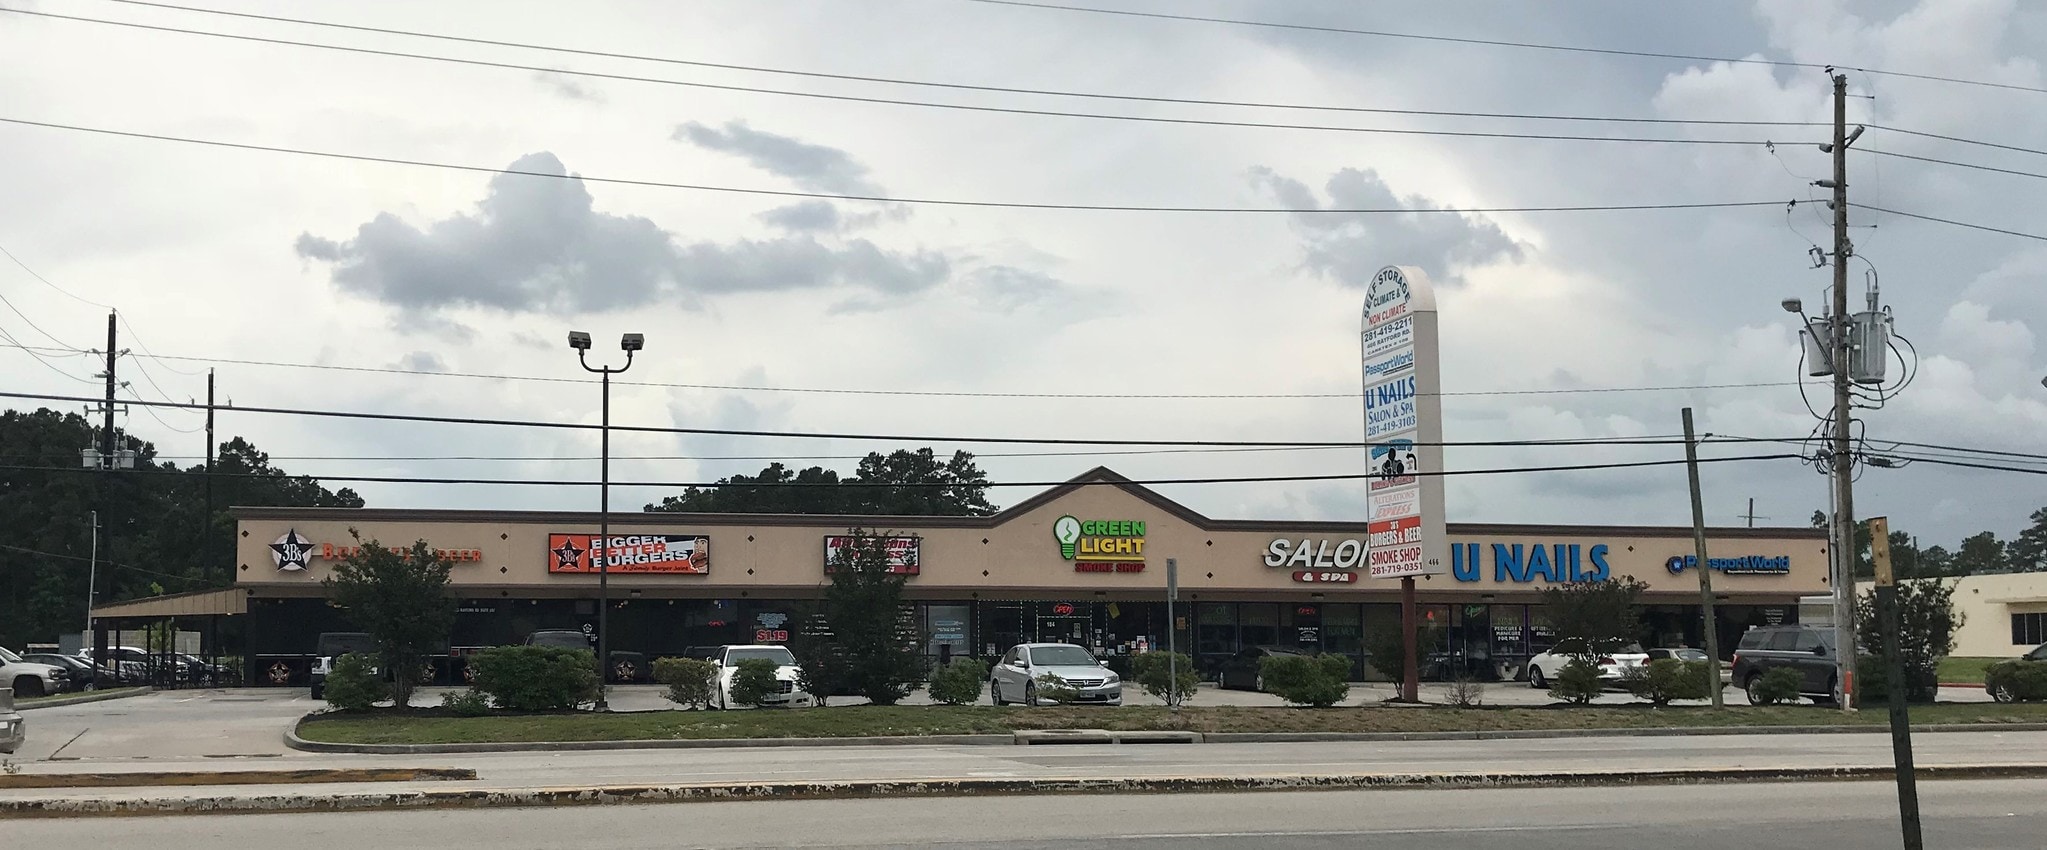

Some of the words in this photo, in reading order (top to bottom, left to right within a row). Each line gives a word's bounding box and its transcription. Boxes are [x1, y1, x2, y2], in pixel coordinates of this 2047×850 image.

[1364, 282, 1376, 319] SELF
[1378, 269, 1411, 304] STORAGE
[1373, 290, 1395, 307] CLIMATE
[1396, 288, 1401, 298] &
[1368, 313, 1381, 325] NON
[1382, 302, 1406, 320] CLIMATE
[1364, 317, 1412, 342] 281-419-2211
[1377, 332, 1401, 345] RAYFORD
[1366, 389, 1374, 410] U
[1378, 376, 1415, 406] NAILS
[1368, 409, 1391, 425] SALON
[1393, 404, 1399, 418] &
[1401, 402, 1414, 416] SPA
[1368, 415, 1416, 436] 281-419-3103
[1374, 490, 1415, 504] ALTERATIONS
[1377, 503, 1412, 517] EXPRESS
[1081, 520, 1146, 536] GREEN
[591, 536, 666, 549] BIGGER
[1370, 530, 1397, 547] BURGERS
[1398, 531, 1404, 543] &
[1405, 526, 1421, 542] BEER
[592, 543, 667, 558] BETTER
[1080, 538, 1145, 553] LIGHT
[593, 550, 689, 568] BURGERS
[1371, 550, 1398, 565] SMOKE
[1400, 547, 1421, 562] SHOP
[1451, 543, 1481, 582] U
[1491, 543, 1610, 583] NAILS
[1075, 563, 1114, 573] SMOKE
[1116, 563, 1146, 573] SHOP
[1372, 562, 1423, 575] 281-719-0351
[1302, 573, 1313, 582] &
[1320, 573, 1349, 582] SPA
[1055, 604, 1073, 614] OPEN
[757, 630, 788, 641] $1.19
